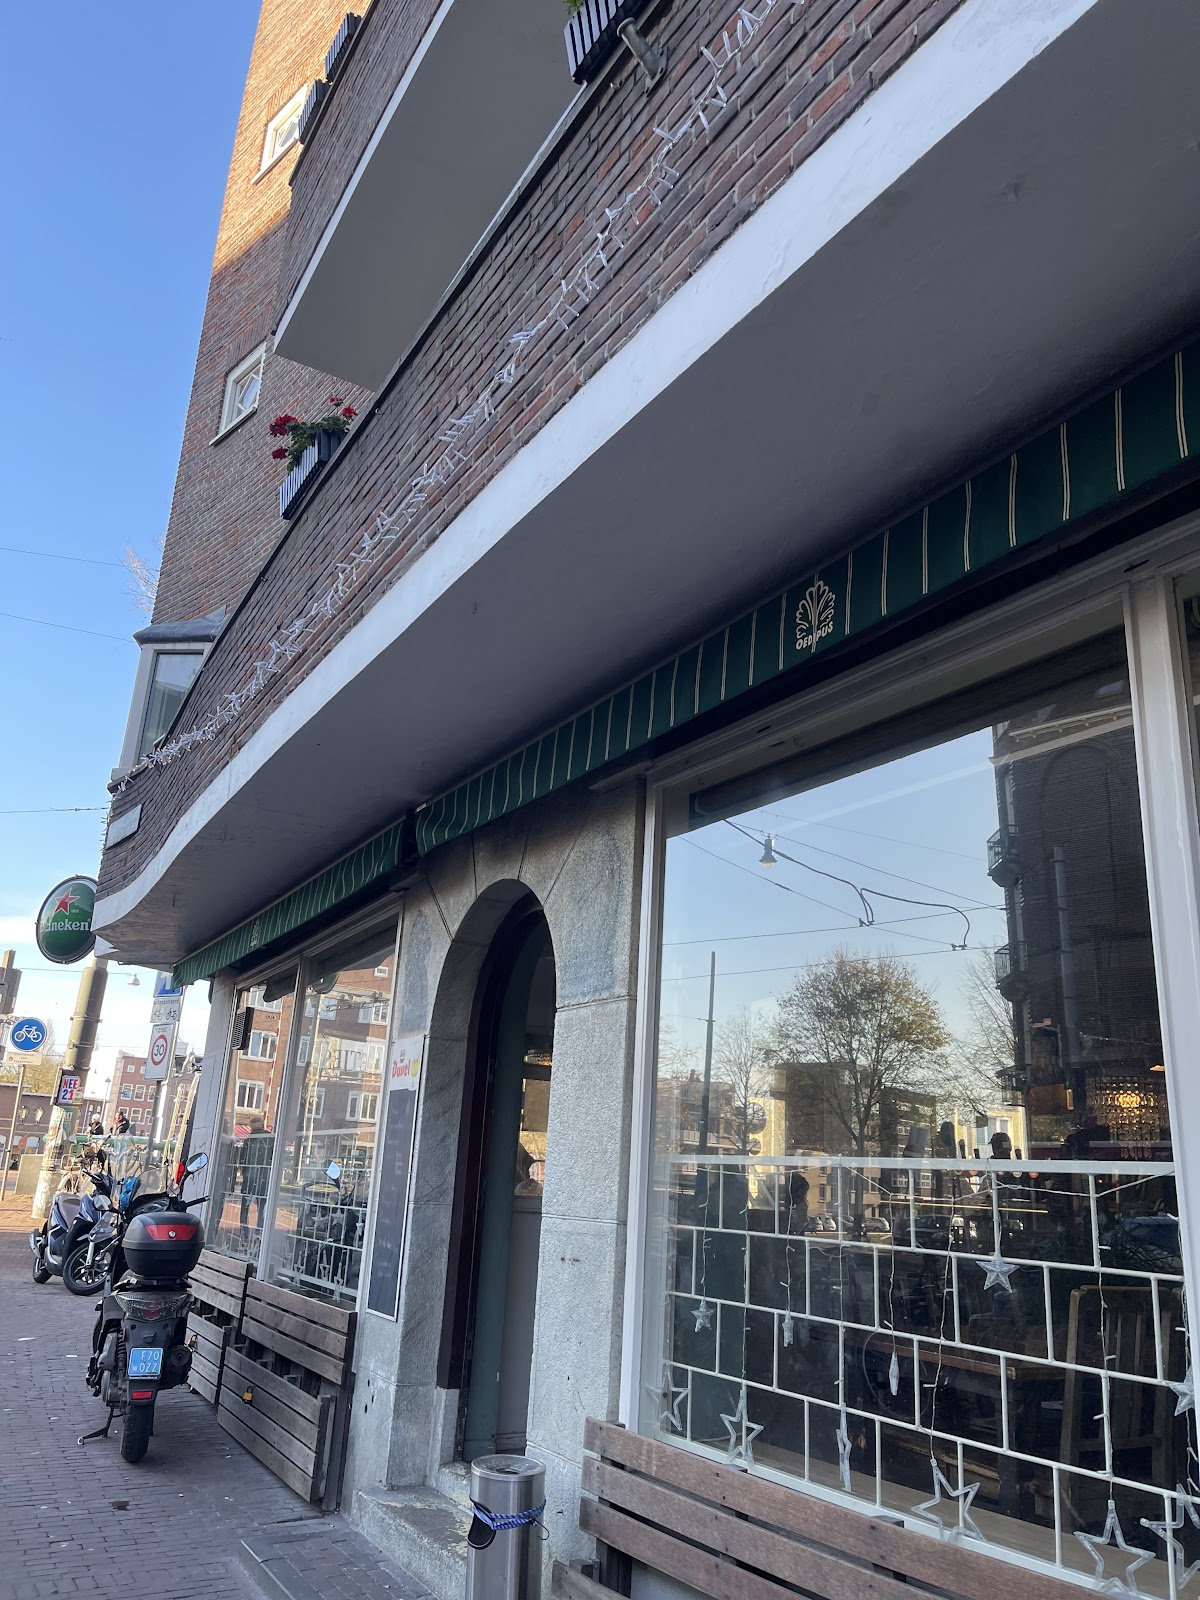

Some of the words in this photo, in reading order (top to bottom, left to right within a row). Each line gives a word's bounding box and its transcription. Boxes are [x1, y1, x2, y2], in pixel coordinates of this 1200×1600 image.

[154, 1044, 165, 1057] 30
[392, 1059, 411, 1078] Duvel
[63, 1079, 78, 1089] NEE
[62, 1089, 74, 1101] 21
